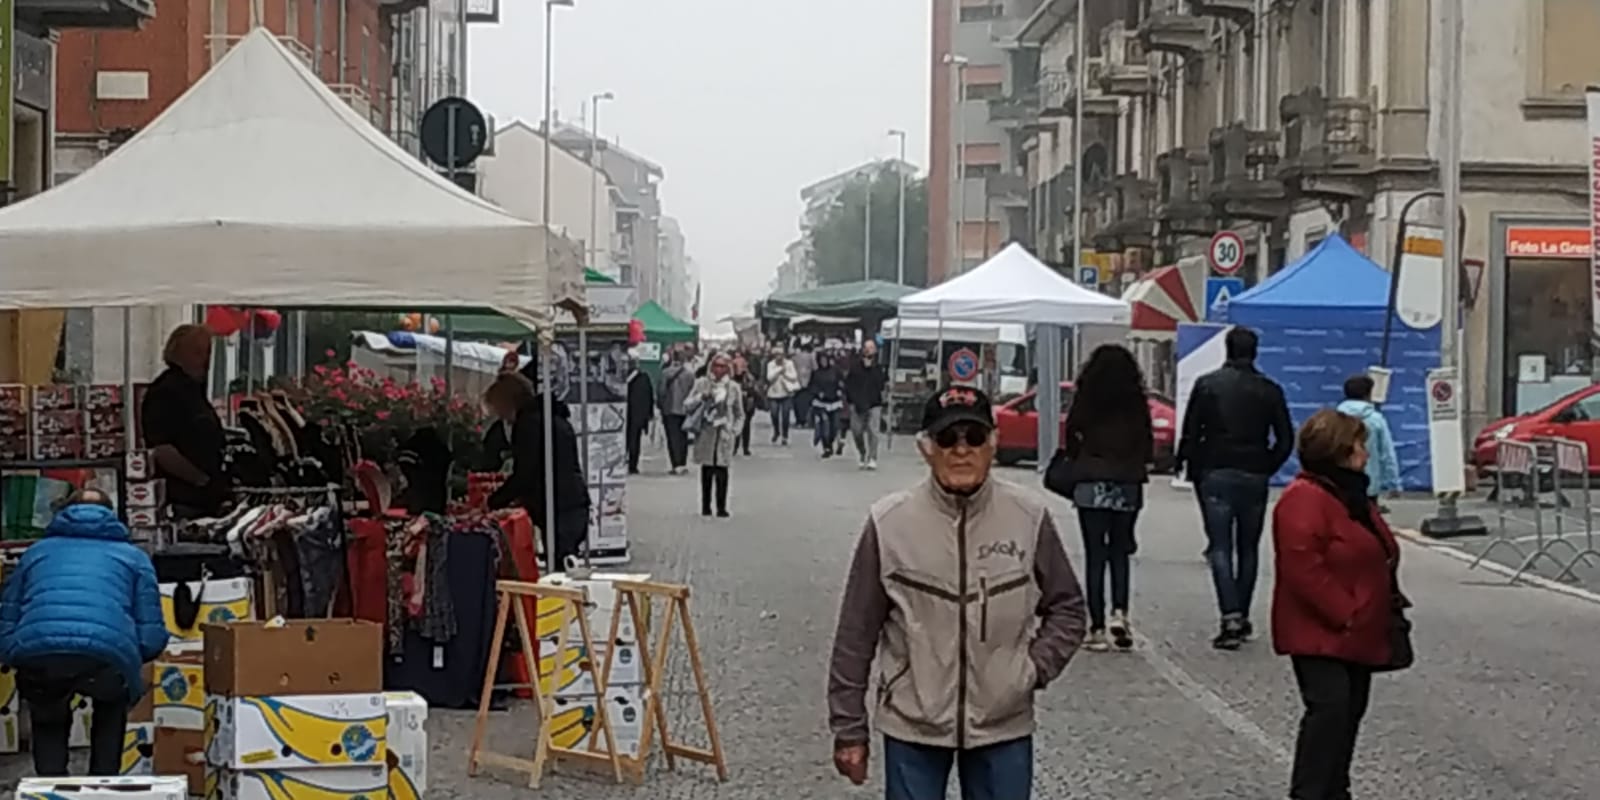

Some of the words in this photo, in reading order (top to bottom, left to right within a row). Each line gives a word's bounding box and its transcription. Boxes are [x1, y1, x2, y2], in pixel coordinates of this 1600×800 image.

[1218, 242, 1237, 263] 30
[1510, 240, 1538, 253] Foto
[1541, 241, 1557, 253] La
[1083, 269, 1094, 283] P
